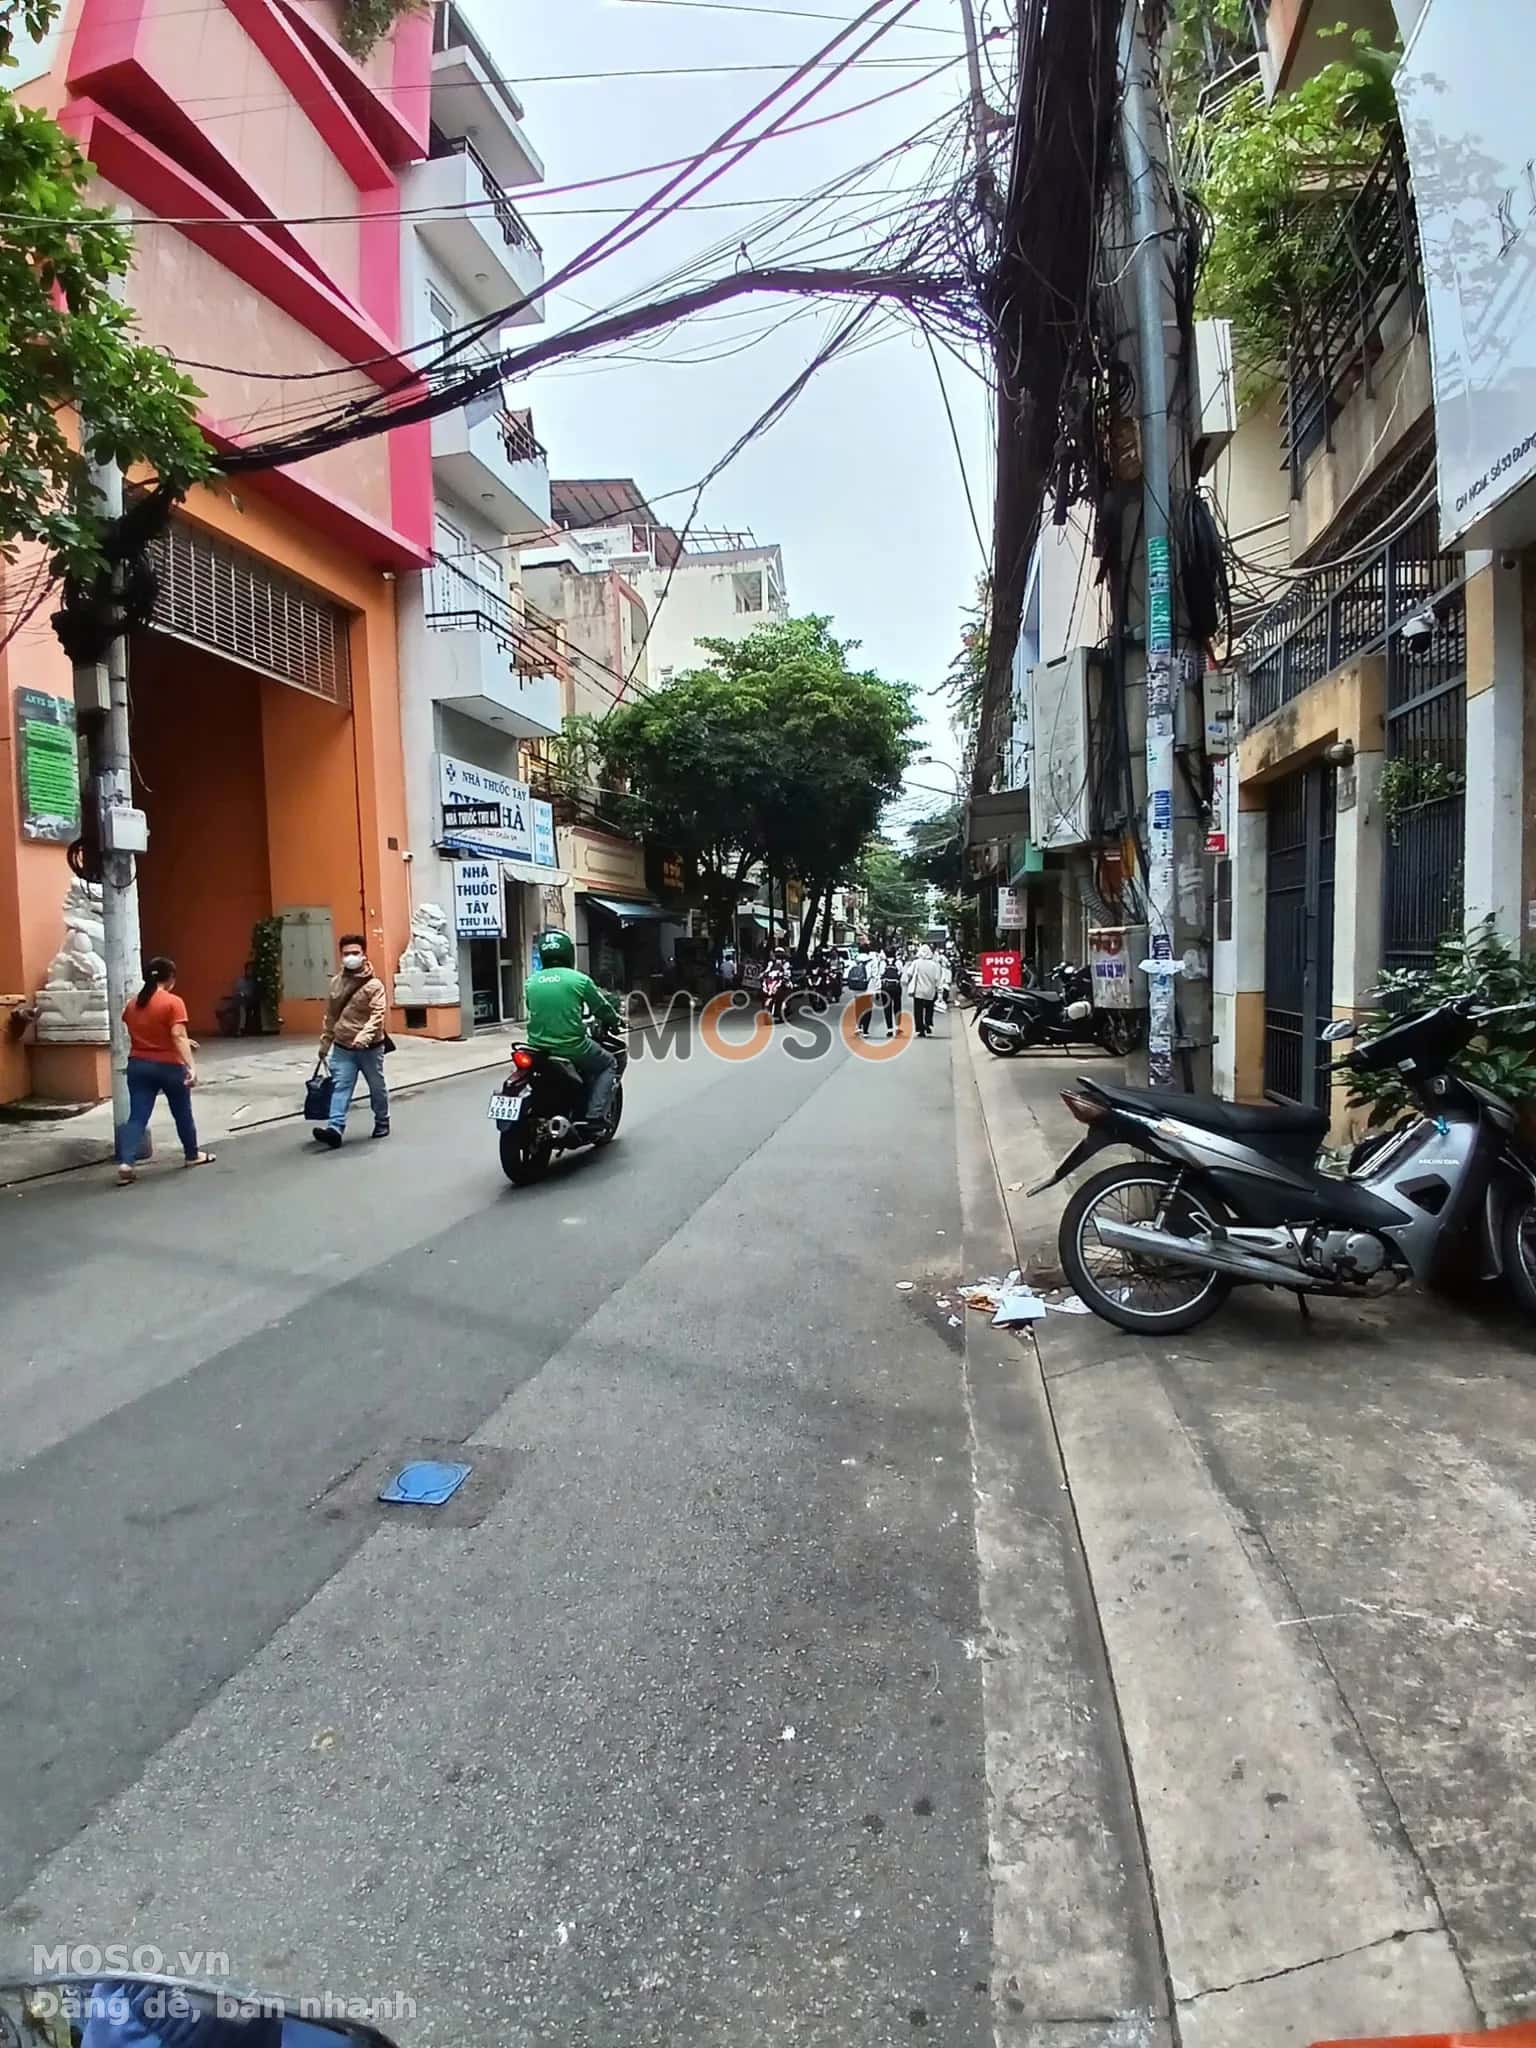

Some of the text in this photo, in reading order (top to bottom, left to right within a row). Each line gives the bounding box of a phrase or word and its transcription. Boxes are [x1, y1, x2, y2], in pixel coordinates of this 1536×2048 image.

[462, 770, 481, 787] NHÀ
[483, 778, 511, 797] THUỐC
[502, 804, 526, 832] HÀ
[462, 863, 489, 879] NHÀ
[456, 879, 498, 897] THUỐC
[465, 900, 489, 915] TÂY
[459, 914, 498, 927] THU HÀ
[985, 956, 1015, 966] PHO
[991, 967, 1010, 976] TO
[991, 977, 1010, 986] CO
